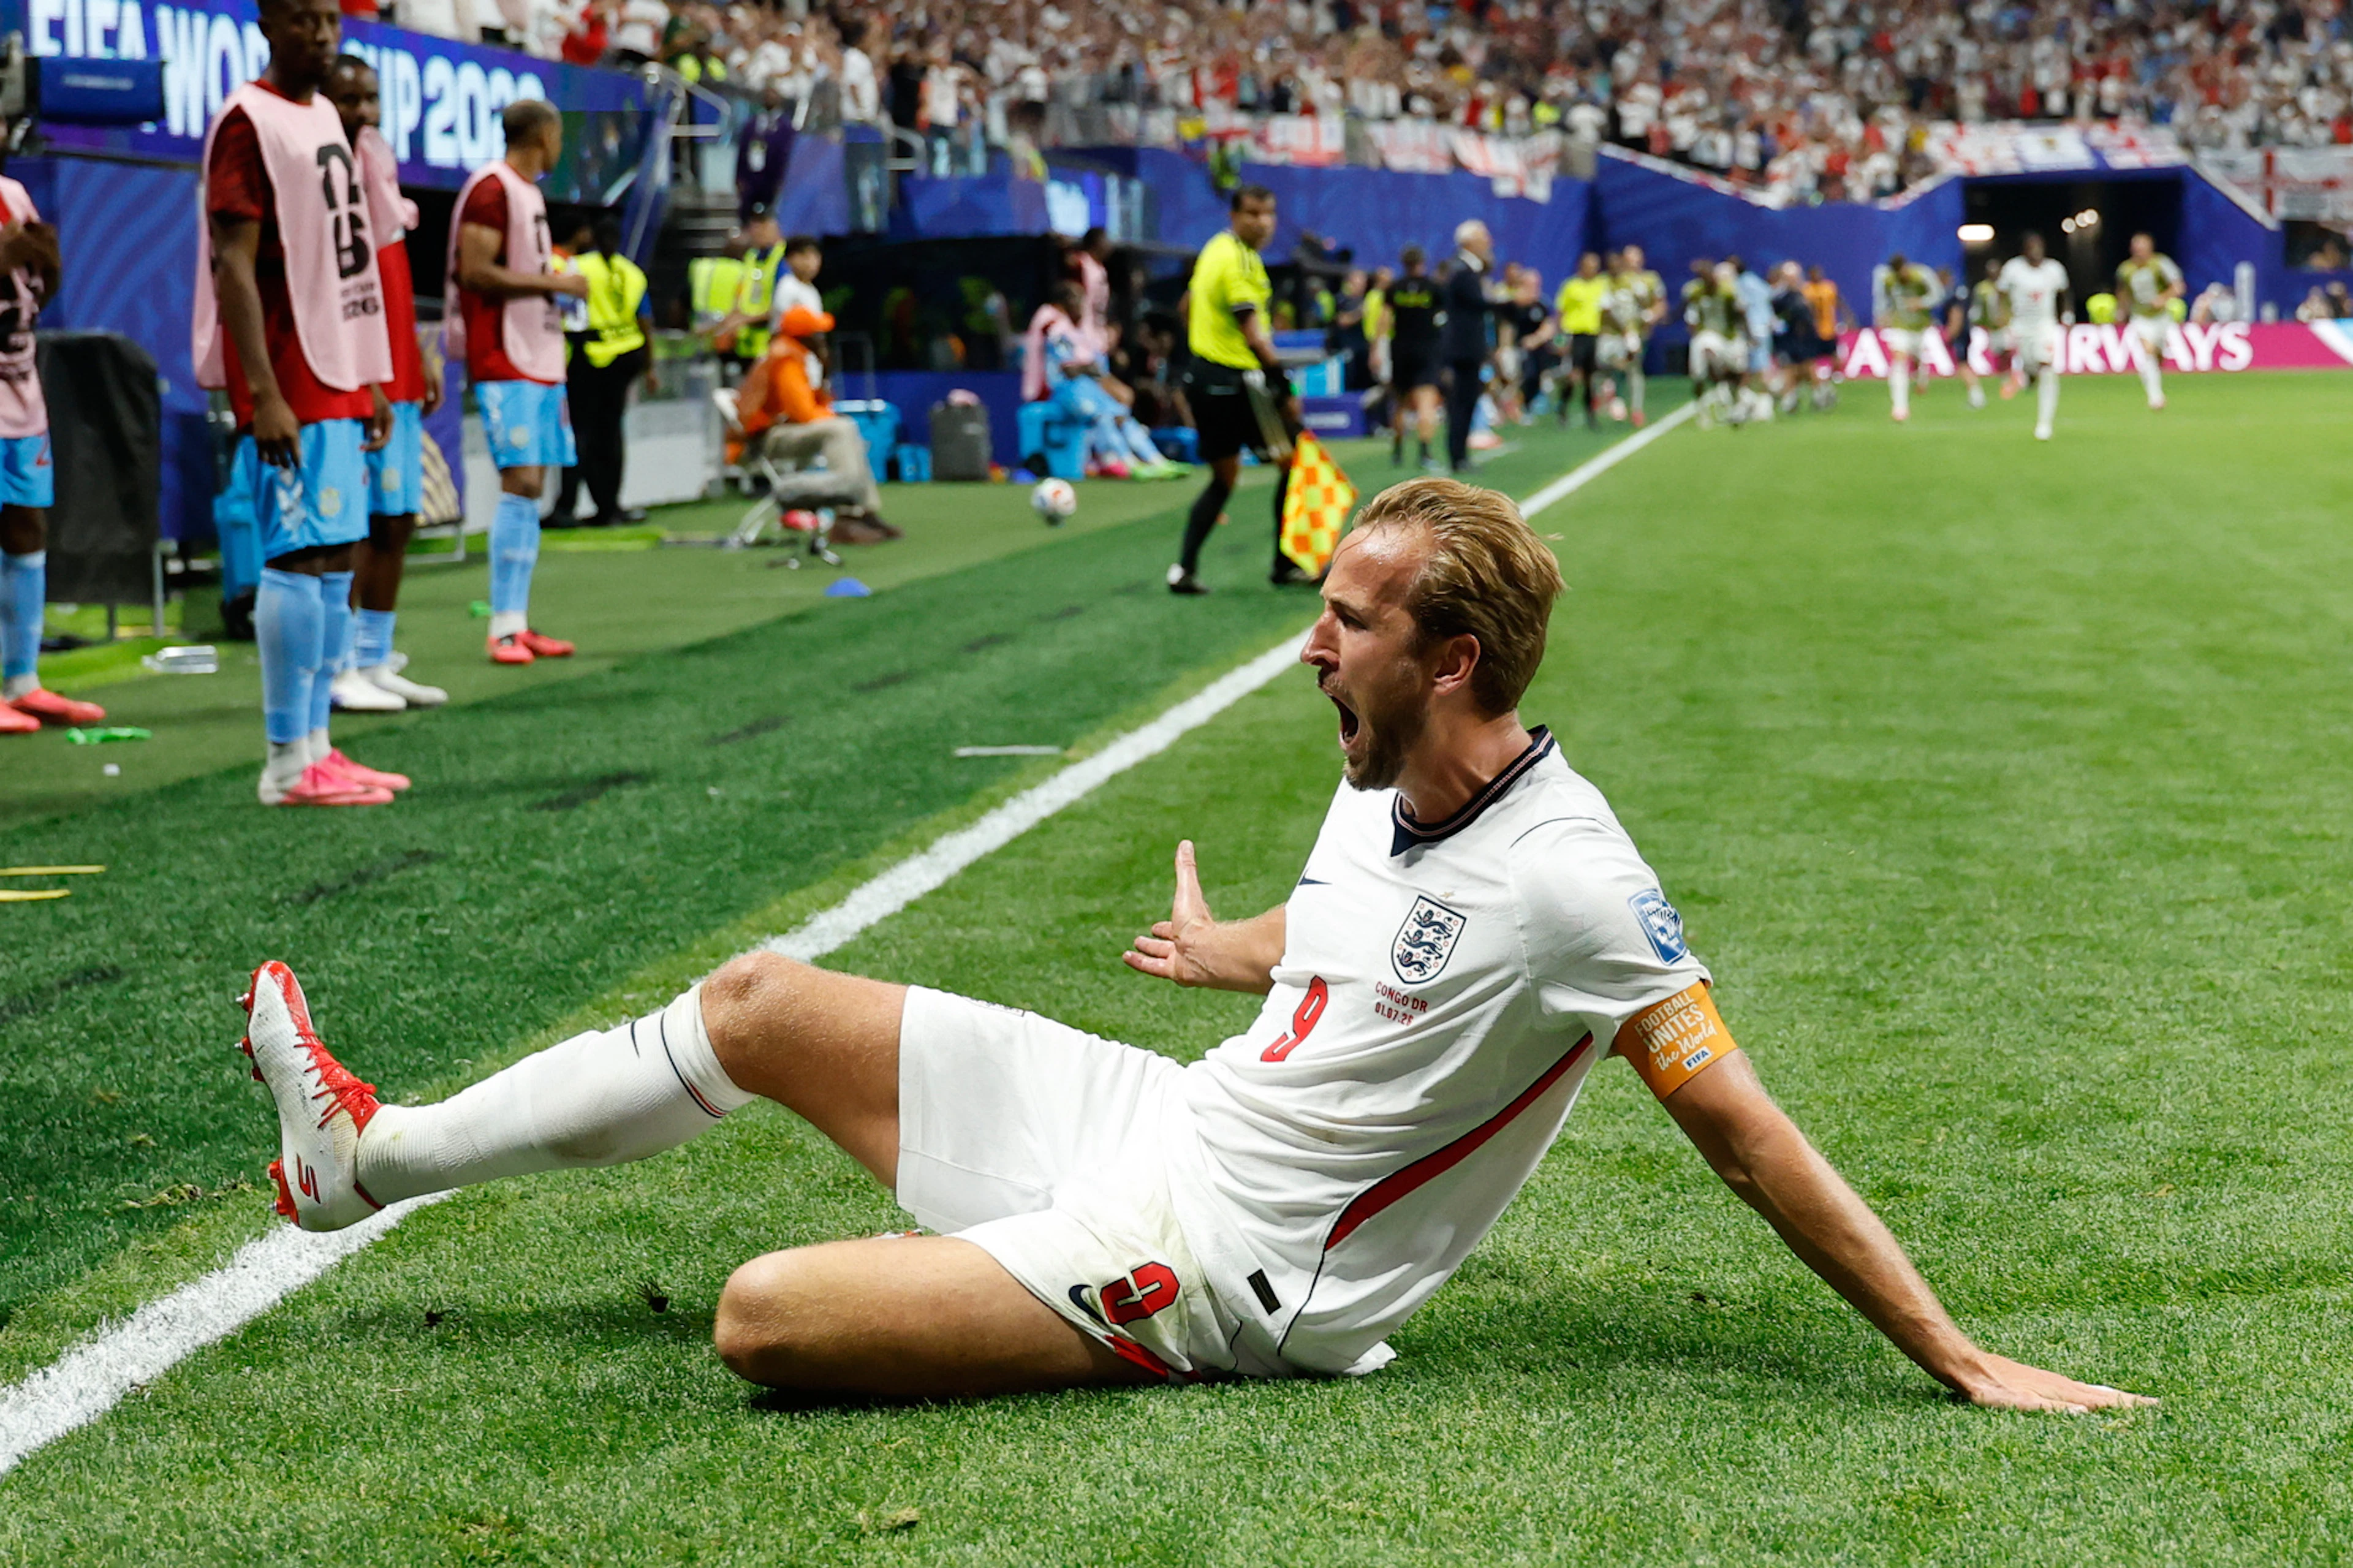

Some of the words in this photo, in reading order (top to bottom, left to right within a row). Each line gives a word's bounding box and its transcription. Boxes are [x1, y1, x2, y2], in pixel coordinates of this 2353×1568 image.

[1260, 975, 1329, 1062] 9
[1375, 981, 1409, 1007] CONGO
[1411, 998, 1428, 1013] DR
[1634, 991, 1695, 1037] FOOTBALL
[1643, 1003, 1705, 1053] UNITES
[1654, 1051, 1680, 1071] the
[1676, 1019, 1718, 1054] World
[1685, 1049, 1710, 1069] FIFA
